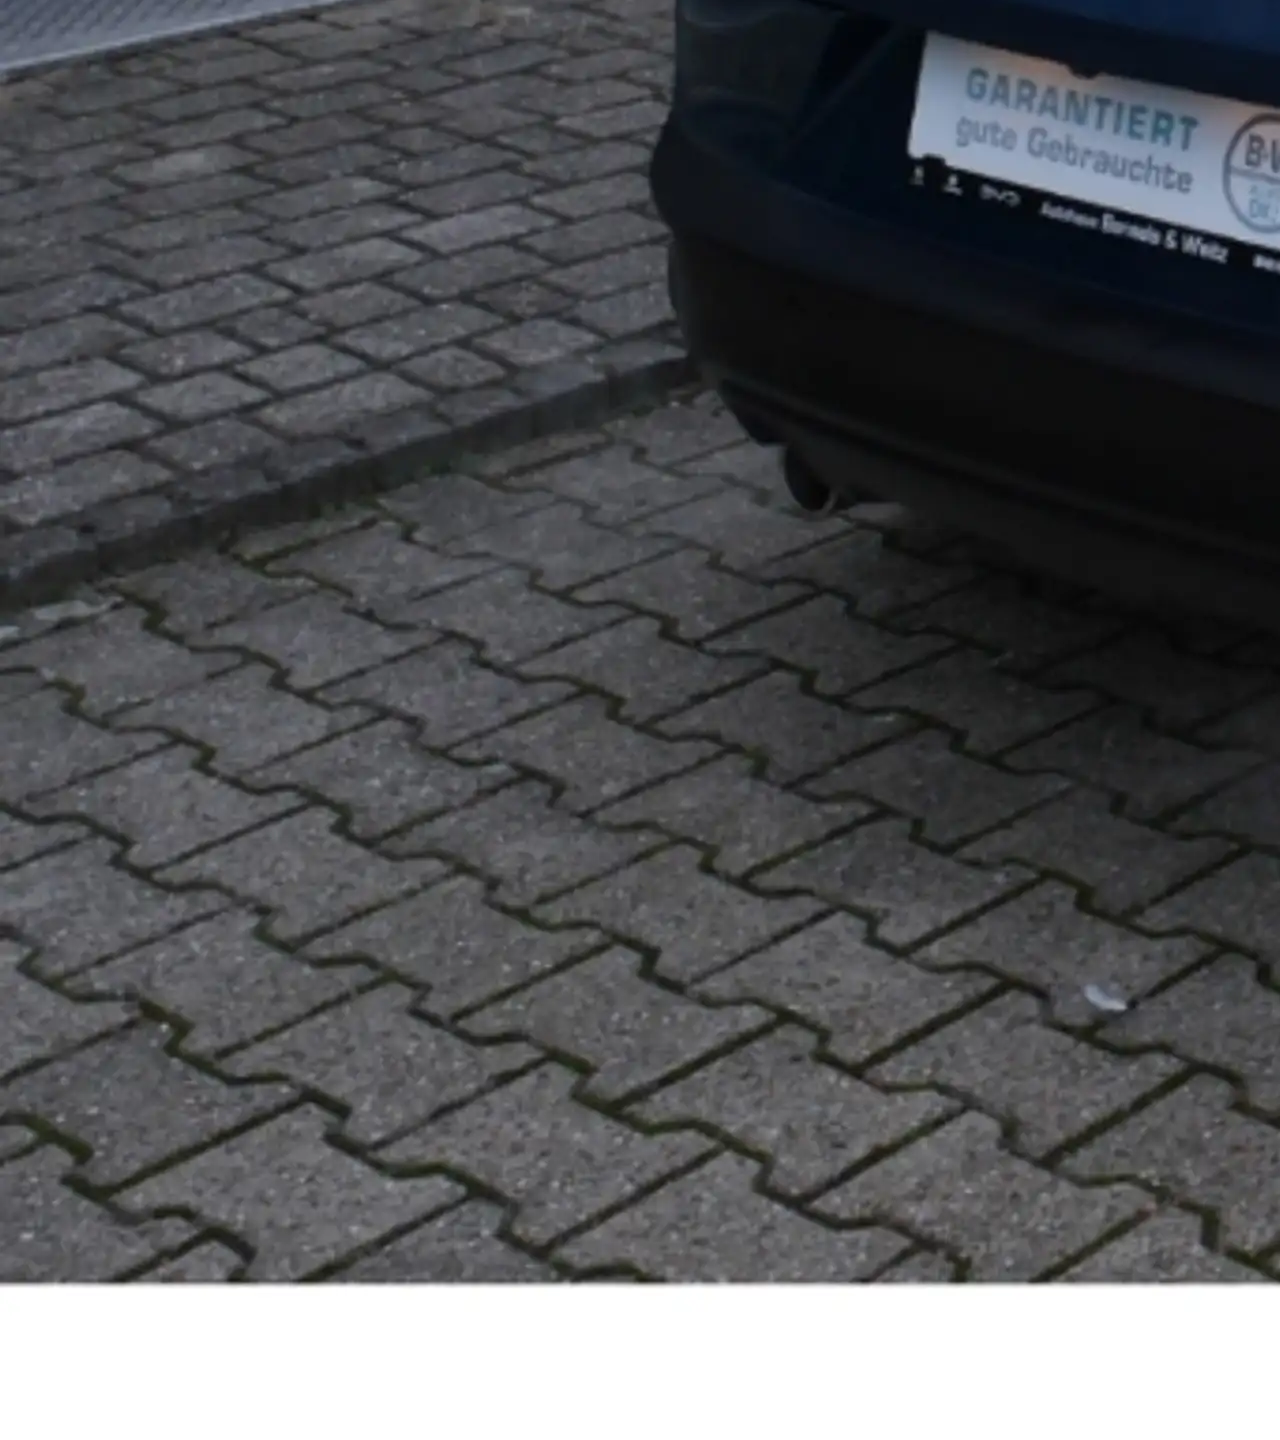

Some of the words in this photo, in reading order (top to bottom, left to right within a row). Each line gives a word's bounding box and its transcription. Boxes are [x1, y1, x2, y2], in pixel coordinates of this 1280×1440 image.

[967, 68, 1199, 152] GARANTIERT
[955, 115, 1018, 151] gute
[1027, 126, 1194, 195] Gebrauchte
